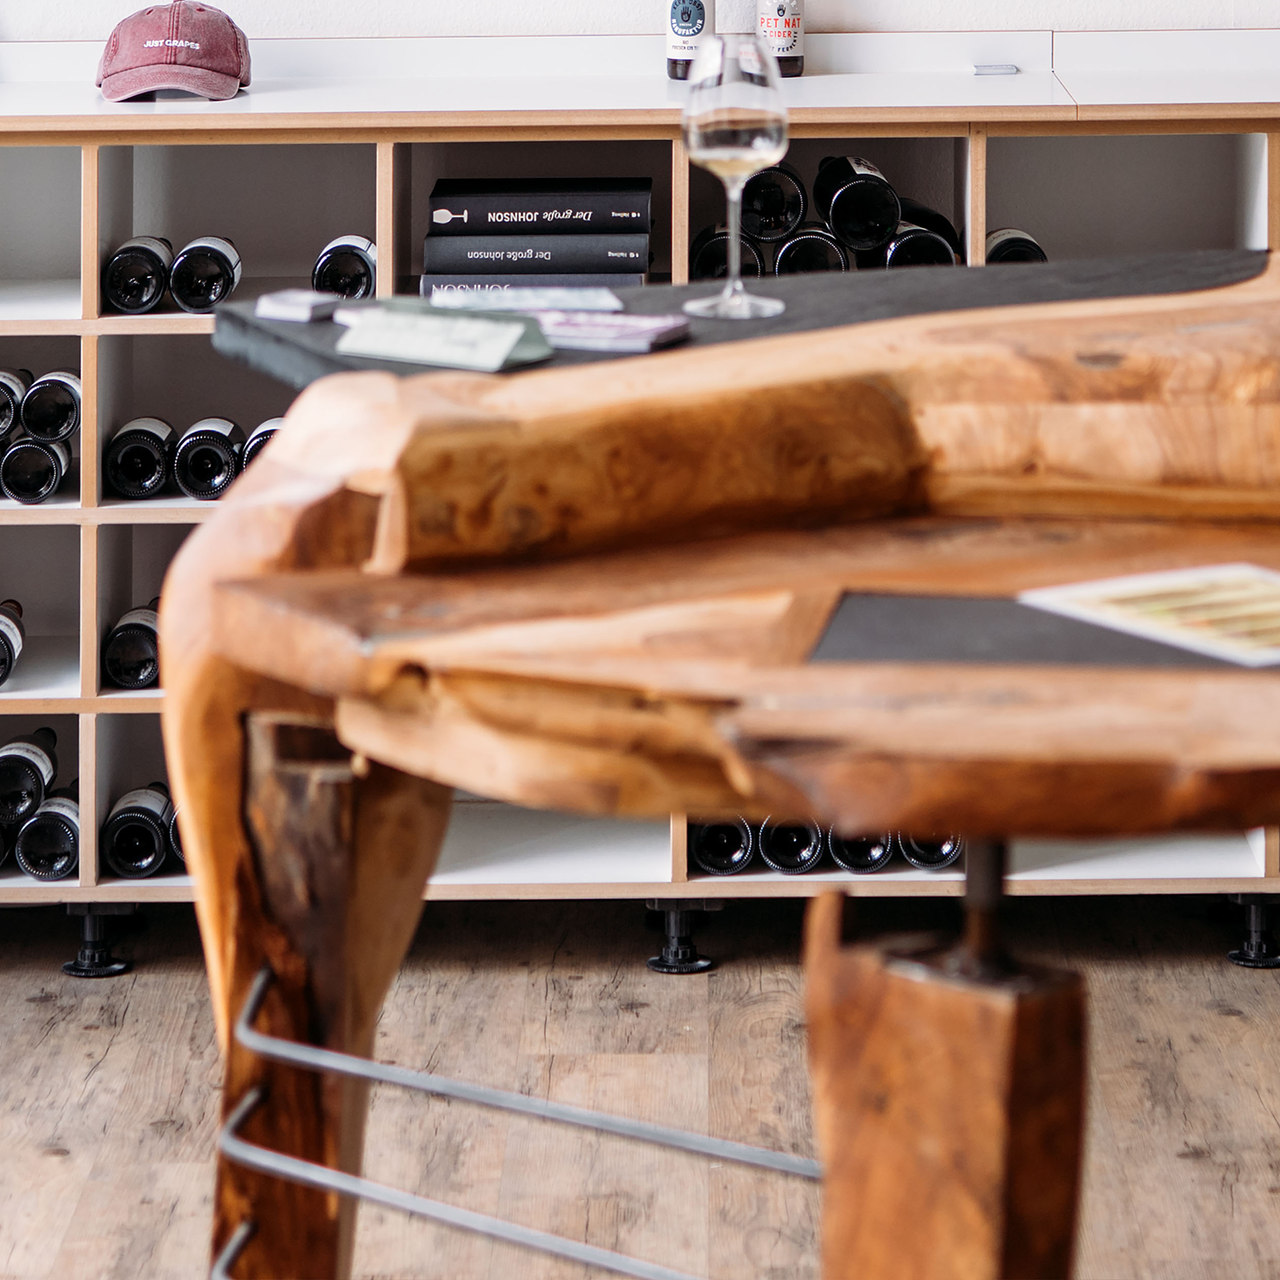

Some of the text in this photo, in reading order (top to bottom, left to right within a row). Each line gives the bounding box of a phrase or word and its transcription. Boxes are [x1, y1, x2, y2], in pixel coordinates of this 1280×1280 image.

[673, 0, 703, 10] KERN OBST
[671, 18, 703, 36] MANUFAKTUR
[760, 17, 801, 28] PET NAT
[143, 39, 200, 50] JUST GRAPES
[487, 208, 594, 222] Der große JOHNSON
[467, 249, 551, 261] Der große Johnson
